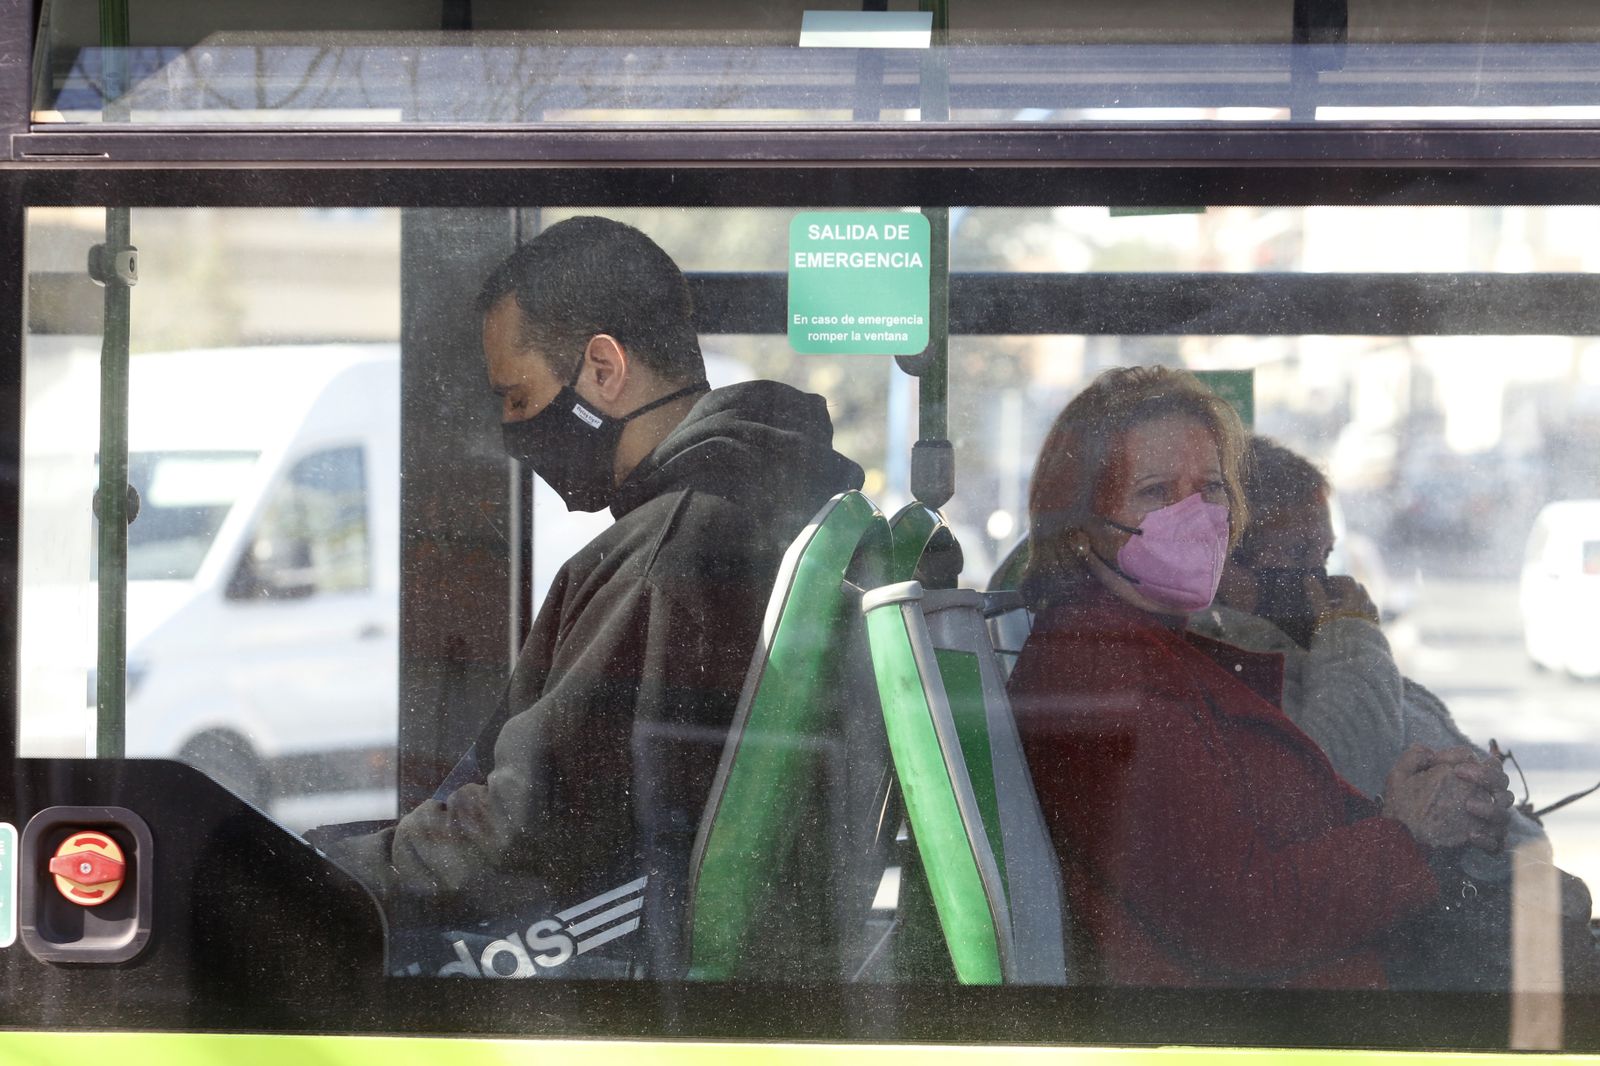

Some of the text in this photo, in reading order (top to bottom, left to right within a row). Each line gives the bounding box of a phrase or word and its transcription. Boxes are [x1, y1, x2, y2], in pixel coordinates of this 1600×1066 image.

[808, 224, 909, 240] SALIDA DE
[795, 252, 922, 268] EMERGENCIA
[793, 314, 924, 327] En caso de emergencia
[808, 331, 909, 343] romper la ventana
